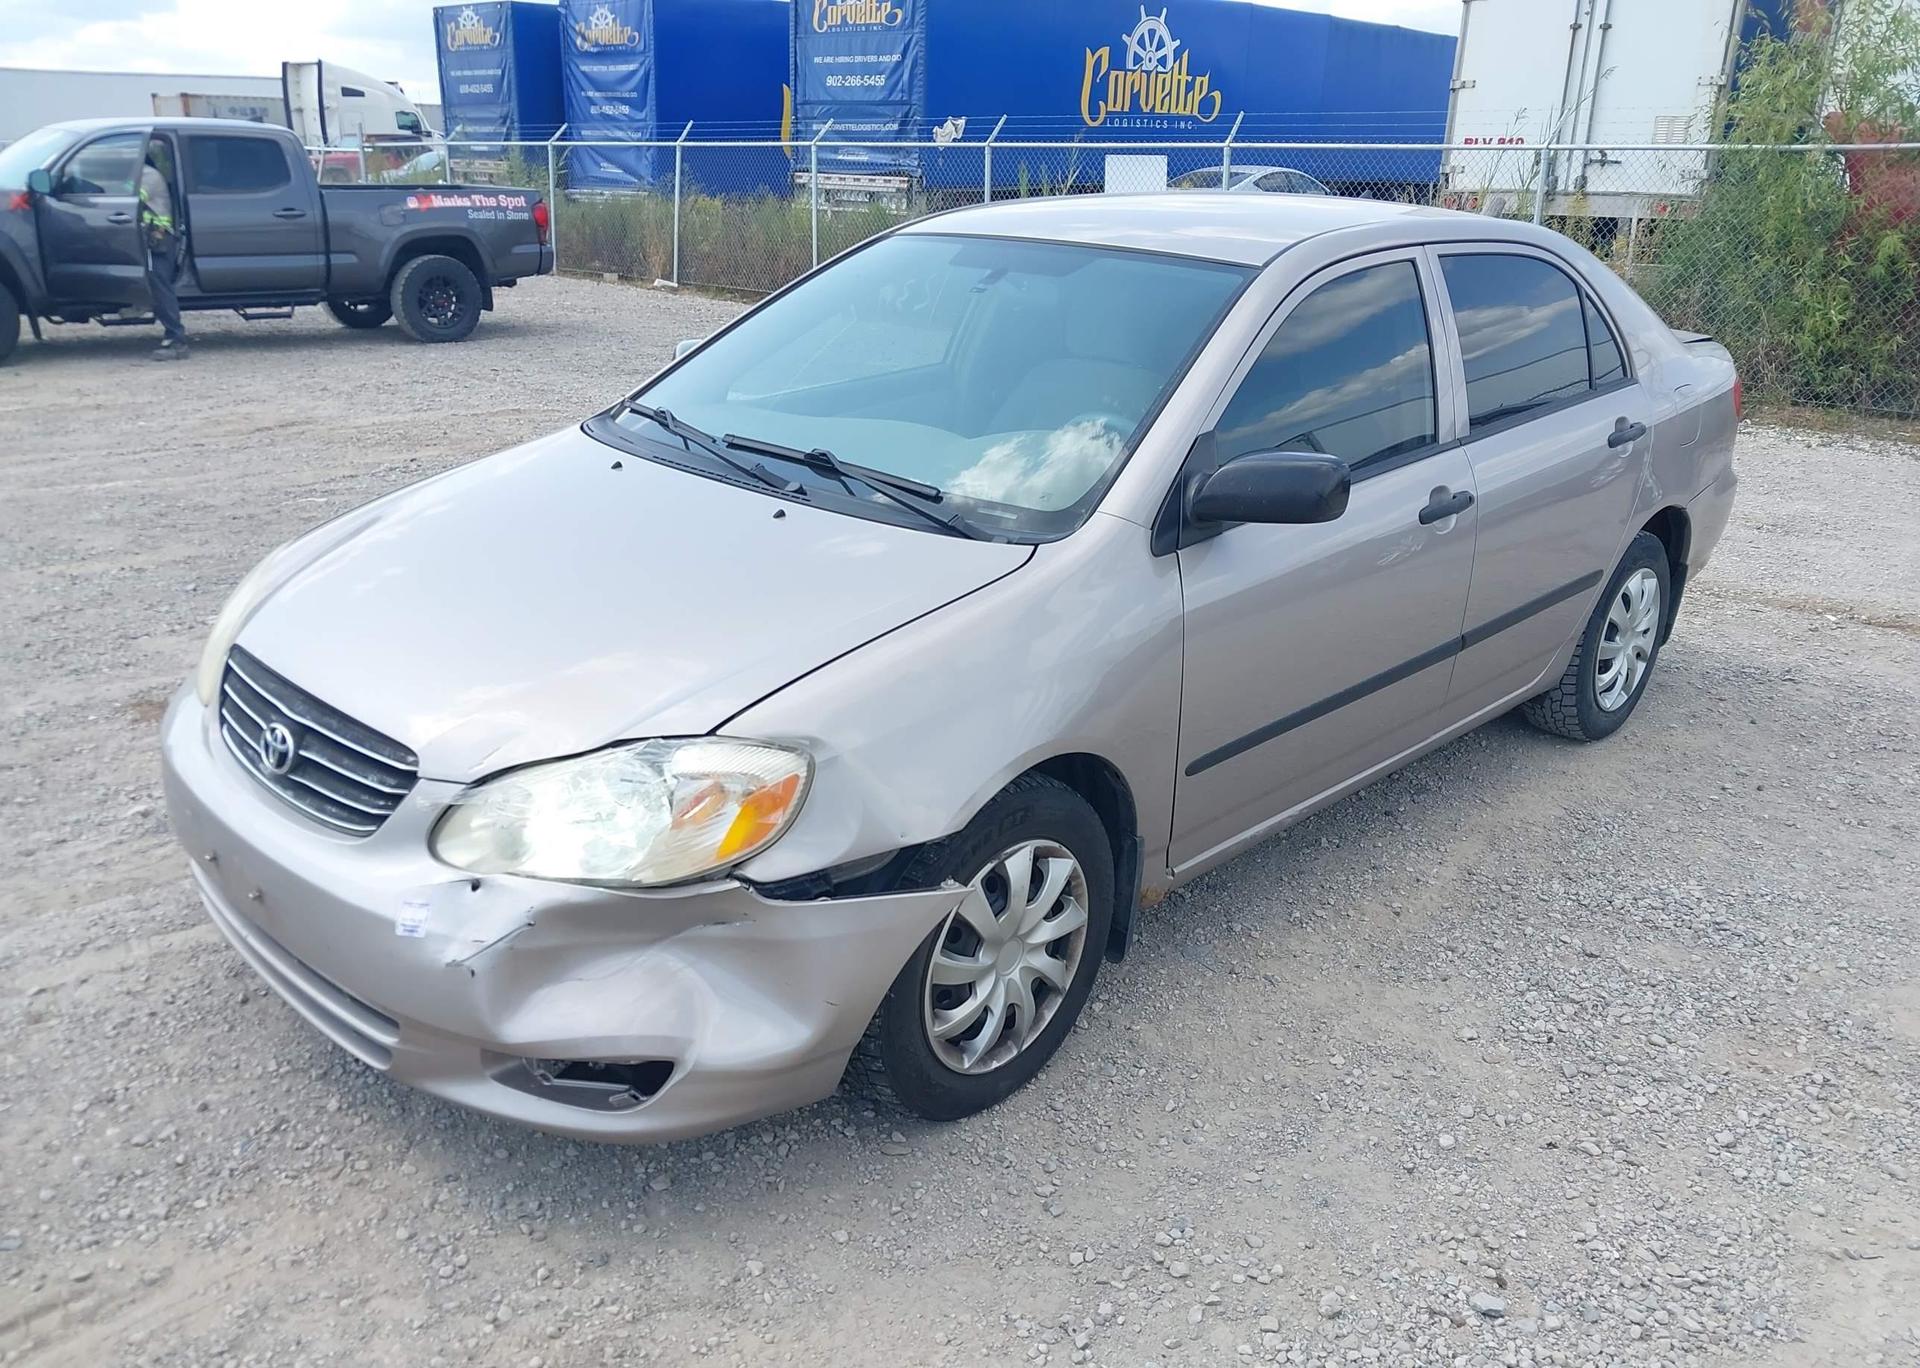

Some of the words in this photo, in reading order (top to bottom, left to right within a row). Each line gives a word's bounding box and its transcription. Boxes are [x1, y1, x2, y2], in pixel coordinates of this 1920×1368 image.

[812, 0, 903, 33] Corvette
[826, 75, 886, 86] 902-266-5455
[1081, 46, 1222, 127] Corvette
[1106, 118, 1168, 129] LOGISTICS
[432, 194, 471, 207] Marks
[472, 195, 497, 206] The
[499, 194, 527, 209] Spot
[467, 209, 495, 219] Sealed
[497, 210, 504, 219] in
[506, 210, 529, 220] Stone
